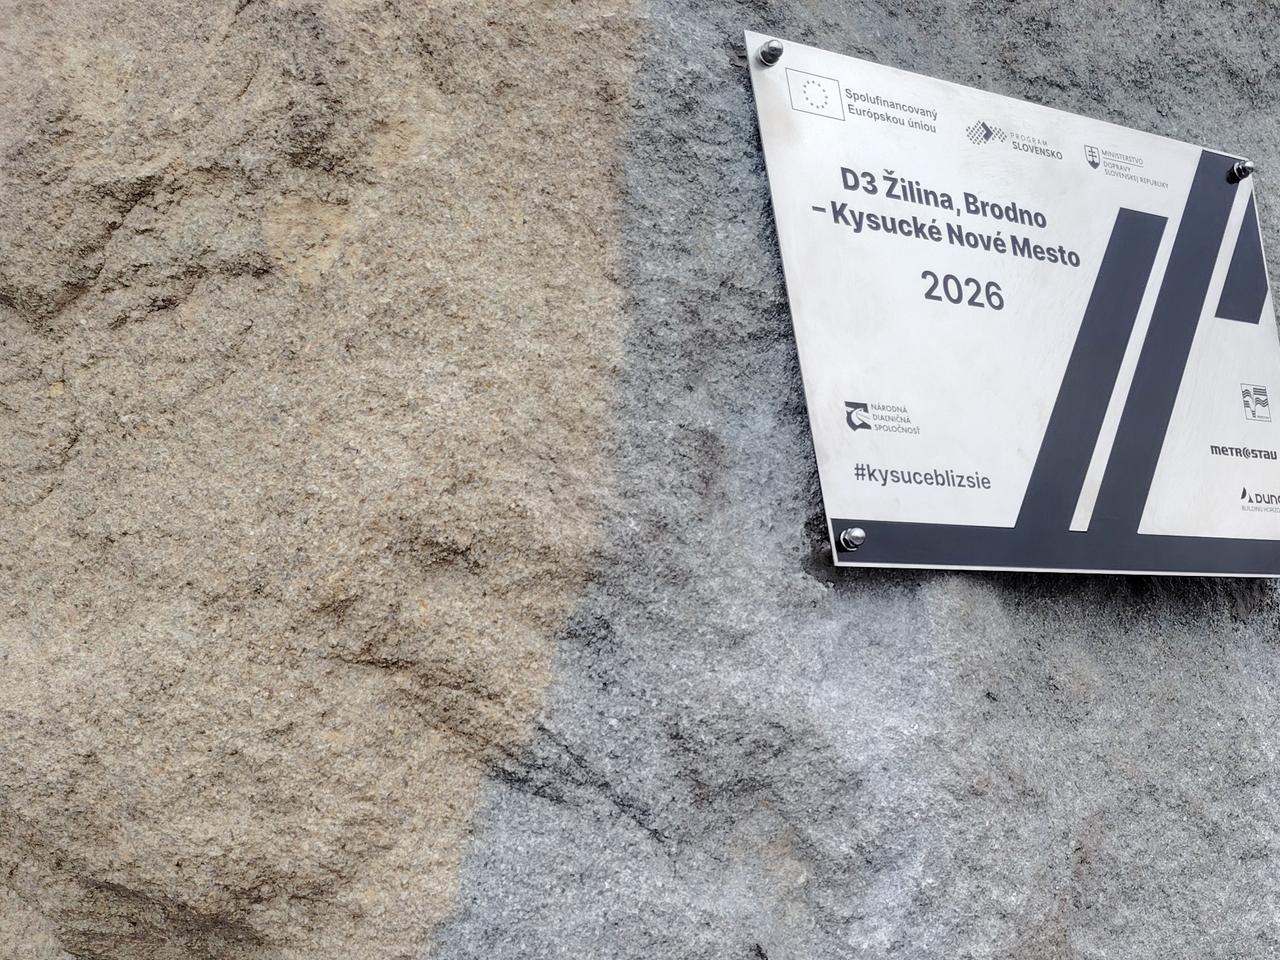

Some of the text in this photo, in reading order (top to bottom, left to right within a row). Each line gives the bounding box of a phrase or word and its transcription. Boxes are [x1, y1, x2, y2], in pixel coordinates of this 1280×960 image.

[845, 88, 938, 121] Spolufinancovaný
[847, 103, 937, 133] Európskou úniou
[1010, 132, 1048, 146] PROGRAM
[1012, 141, 1063, 160] SLOVENSKO
[1101, 149, 1144, 165] MINISTERSTVO
[1103, 161, 1131, 173] DOPRAVY
[1104, 169, 1139, 183] SLOVENSKEJ
[840, 166, 1047, 229] D3 Žilina, Brodno
[831, 200, 943, 242] Kysucké
[946, 222, 1007, 254] Nové
[1010, 234, 1081, 268] Mesto
[921, 270, 1005, 311] 2026
[871, 402, 908, 413] NÁRODNÁ
[854, 463, 992, 489] #kysuceblizsie
